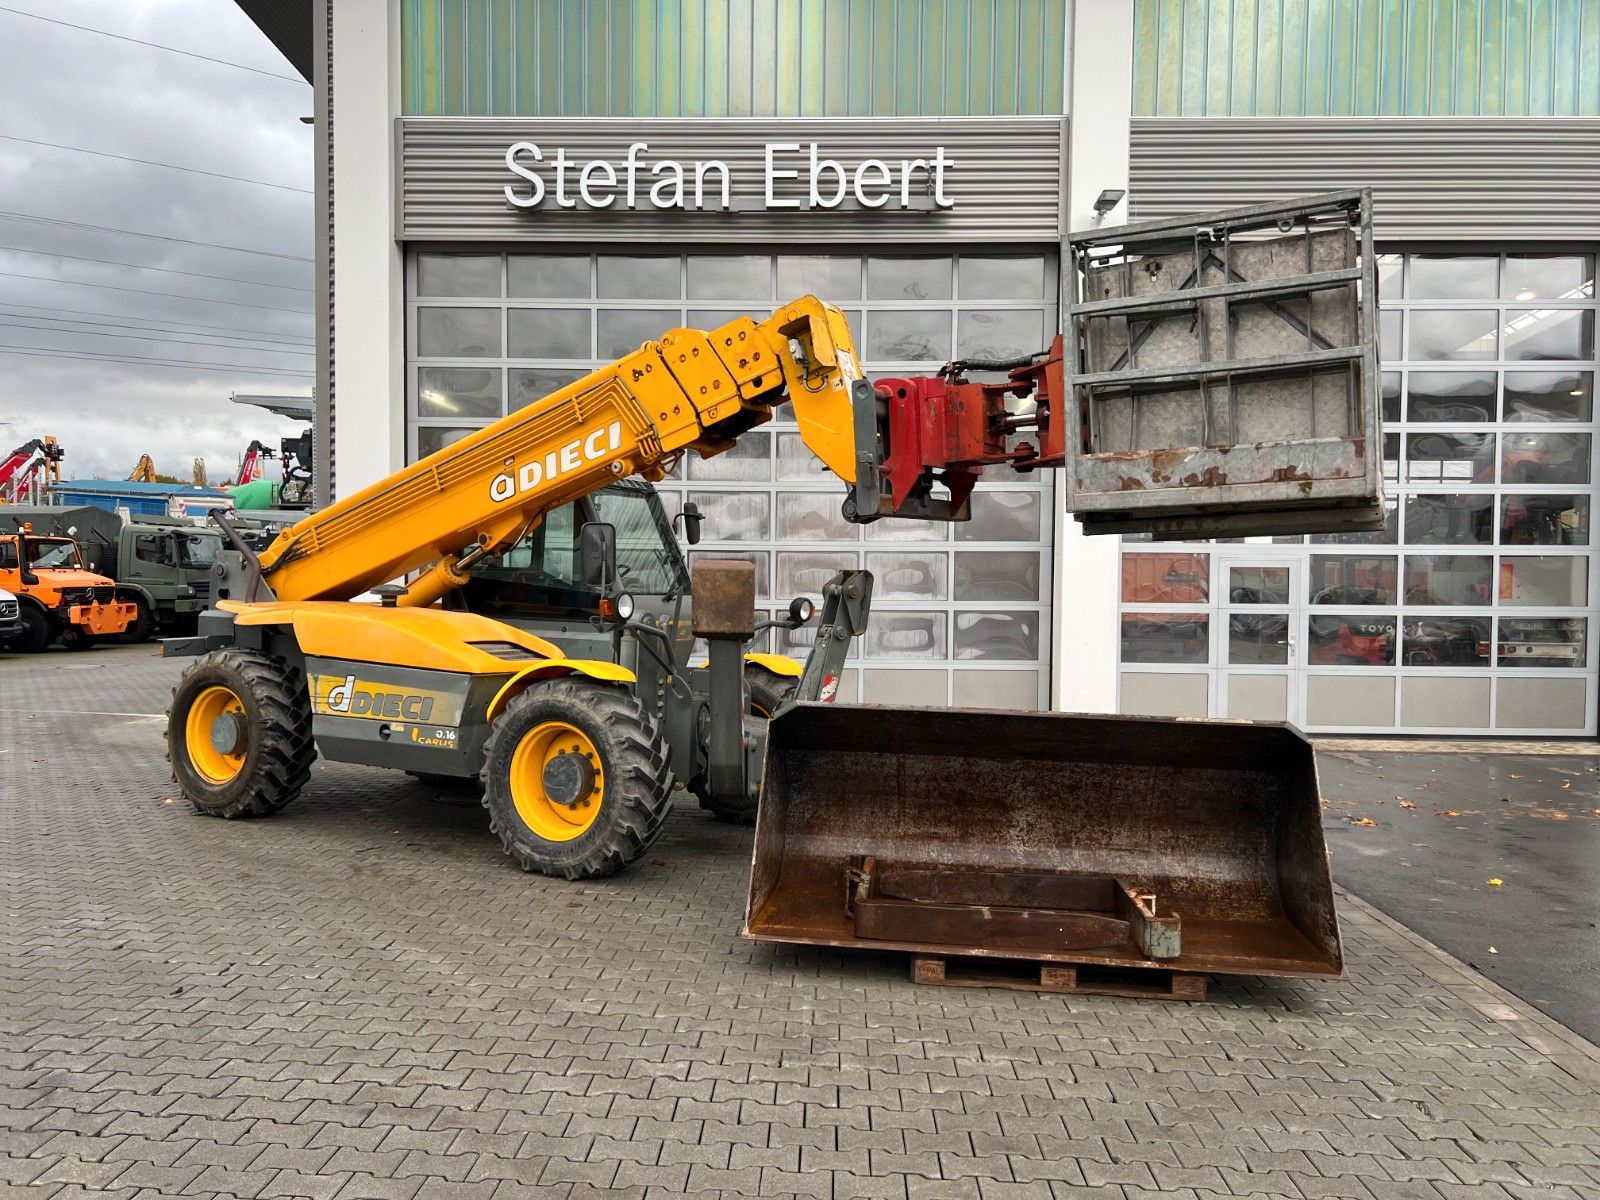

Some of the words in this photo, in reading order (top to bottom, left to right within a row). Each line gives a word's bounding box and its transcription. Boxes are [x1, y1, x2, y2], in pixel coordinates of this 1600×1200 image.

[503, 141, 730, 209] Stefan
[764, 141, 955, 209] Ebert
[519, 420, 622, 493] DIECI
[1360, 624, 1408, 633] TOYOA
[350, 691, 434, 720] DIECI
